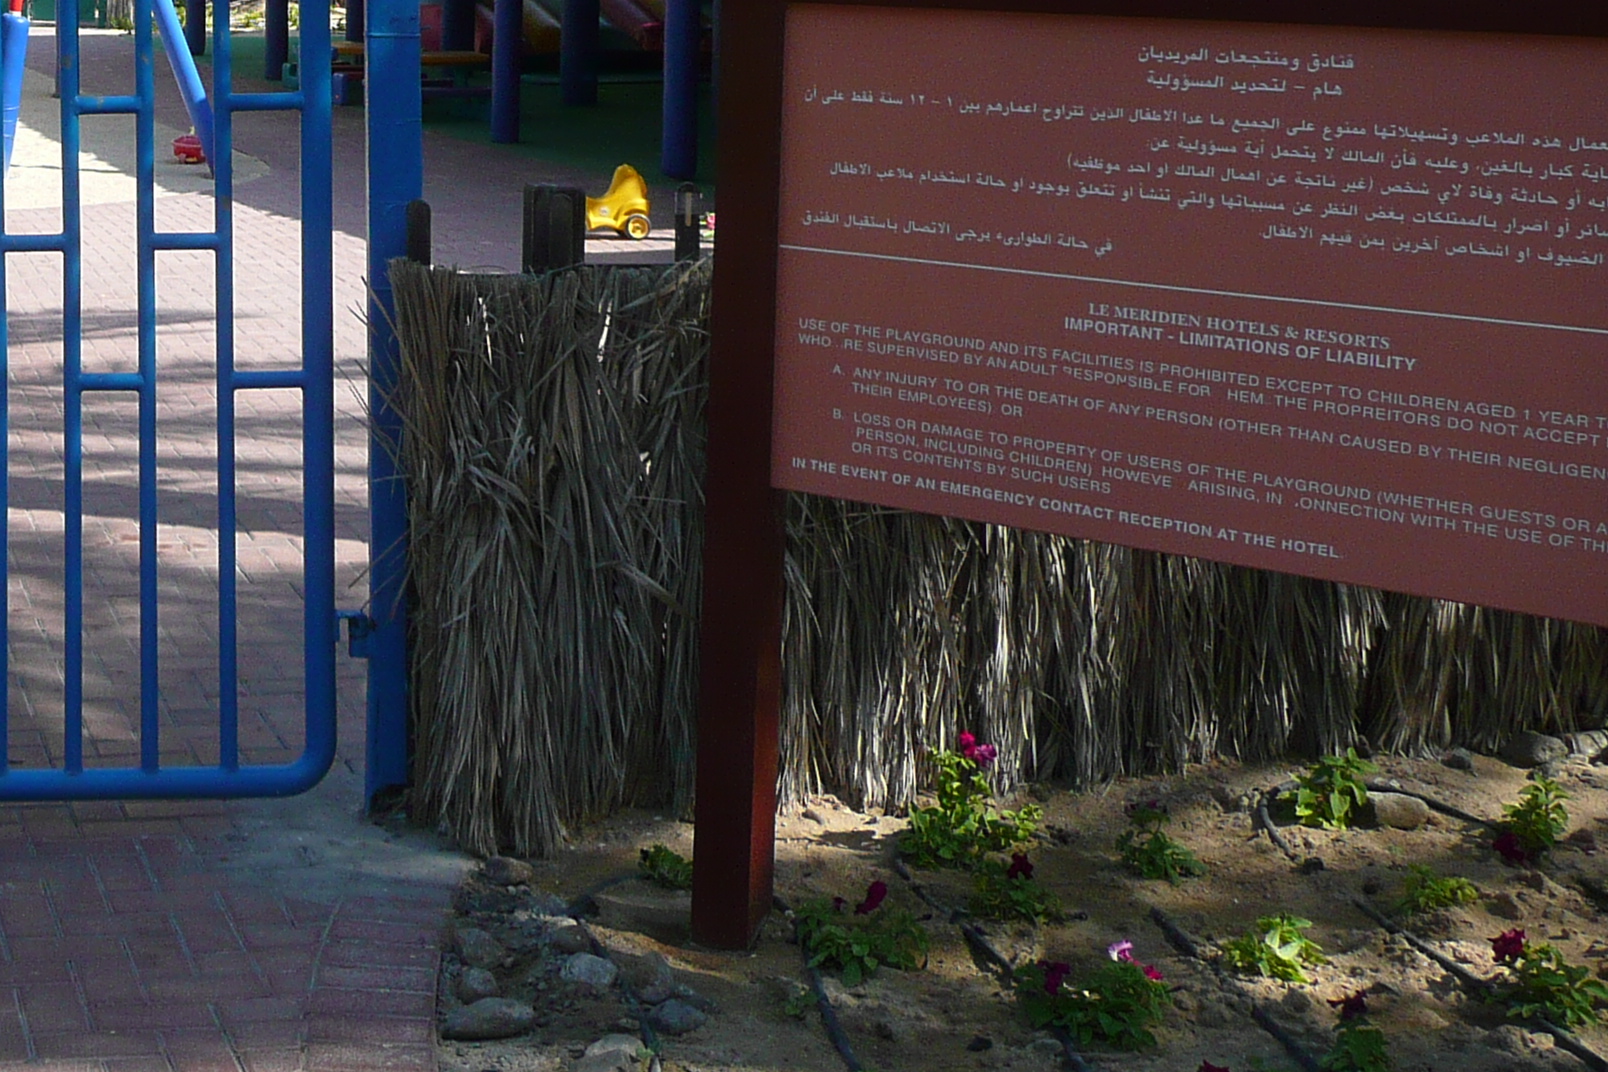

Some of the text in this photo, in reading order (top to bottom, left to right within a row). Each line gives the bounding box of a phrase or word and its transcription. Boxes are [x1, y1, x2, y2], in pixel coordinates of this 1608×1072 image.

[798, 317, 826, 332] USE
[830, 321, 850, 334] OF
[853, 324, 881, 339] THE
[885, 328, 986, 351] PLAYGROUND
[988, 340, 1019, 355] AND
[1023, 345, 1047, 359] ITS
[1052, 348, 1135, 371] FACILITIES
[1139, 360, 1154, 374] IS
[1159, 362, 1260, 387] PROHIBITED
[1265, 376, 1334, 396] EXCEPT
[1337, 385, 1362, 400] TO
[1367, 389, 1460, 412] CHILDREN
[1463, 401, 1516, 419] AGED
[1523, 409, 1530, 421] 1
[1538, 410, 1589, 428] YEAR
[1064, 316, 1164, 341] IMPORTANT
[1179, 330, 1290, 357] LIMITATIONS
[1295, 344, 1321, 360] OF
[1325, 347, 1417, 372] LIABILITY
[1088, 302, 1390, 350] LE MERIDIEN HOTELS & RESORTS
[798, 332, 832, 348] WHO
[839, 338, 863, 352] RE
[867, 341, 960, 363] SUPERVISED
[963, 352, 983, 366] BY
[985, 356, 1007, 369] AN
[1009, 359, 1058, 376] ADULT
[1178, 382, 1211, 397] FOR
[1313, 399, 1441, 428] PROPREITORS
[1447, 416, 1474, 432] DO
[1479, 420, 1519, 437] NOT
[1523, 426, 1601, 447] ACCEPT
[851, 381, 893, 398] THEIR
[1000, 403, 1023, 418] OR
[852, 367, 882, 381] ANY
[885, 371, 938, 388] INJURY
[943, 378, 964, 392] TO
[967, 381, 990, 396] OR
[994, 385, 1023, 401] THE
[1027, 389, 1079, 408] DEATH
[1082, 397, 1105, 411] OF
[1108, 401, 1141, 416] ANY
[1145, 406, 1214, 428] PERSON
[1218, 417, 1282, 437] (OTHER
[1287, 426, 1334, 444] THAN
[1339, 433, 1412, 455] CAUSED
[1418, 444, 1442, 459] BY
[1447, 447, 1501, 467] THEIR
[1507, 455, 1608, 481] NEGLIGEN
[791, 456, 806, 470] IN
[809, 458, 837, 475] THE
[841, 463, 888, 483] EVENT
[891, 472, 912, 486] OF
[914, 476, 936, 491] AN
[939, 480, 1035, 507] EMERGENCY
[1038, 497, 1115, 521] CONTACT
[1118, 510, 1213, 538] RECEPTION
[1216, 527, 1239, 542] AT
[1242, 531, 1276, 548] THE
[851, 441, 1111, 494] OR ITS CONTENTS BY SUCH USERS
[853, 411, 891, 428] LOSS
[895, 417, 917, 431] OR
[920, 421, 983, 442] DAMAGE
[988, 431, 1009, 445] TO
[1012, 435, 1097, 459] PROPERTY
[1100, 449, 1123, 463] OF
[1127, 453, 1182, 473] USERS
[1187, 462, 1211, 476] OF
[1214, 466, 1247, 482] THE
[1252, 472, 1371, 500] PLAYGROUND
[1376, 491, 1474, 516] (WHETHER
[1479, 505, 1556, 528] GUESTS
[1562, 517, 1591, 533] OR
[924, 437, 1005, 461] INCLUDING
[1101, 465, 1172, 488] HOWEVE
[1266, 491, 1283, 506] IN
[1294, 496, 1405, 524] ONNECTION
[1410, 512, 1456, 531] WITH
[1462, 519, 1499, 538] THE
[1504, 527, 1542, 544] USE
[1548, 533, 1575, 548] OF
[1580, 536, 1608, 553] TH
